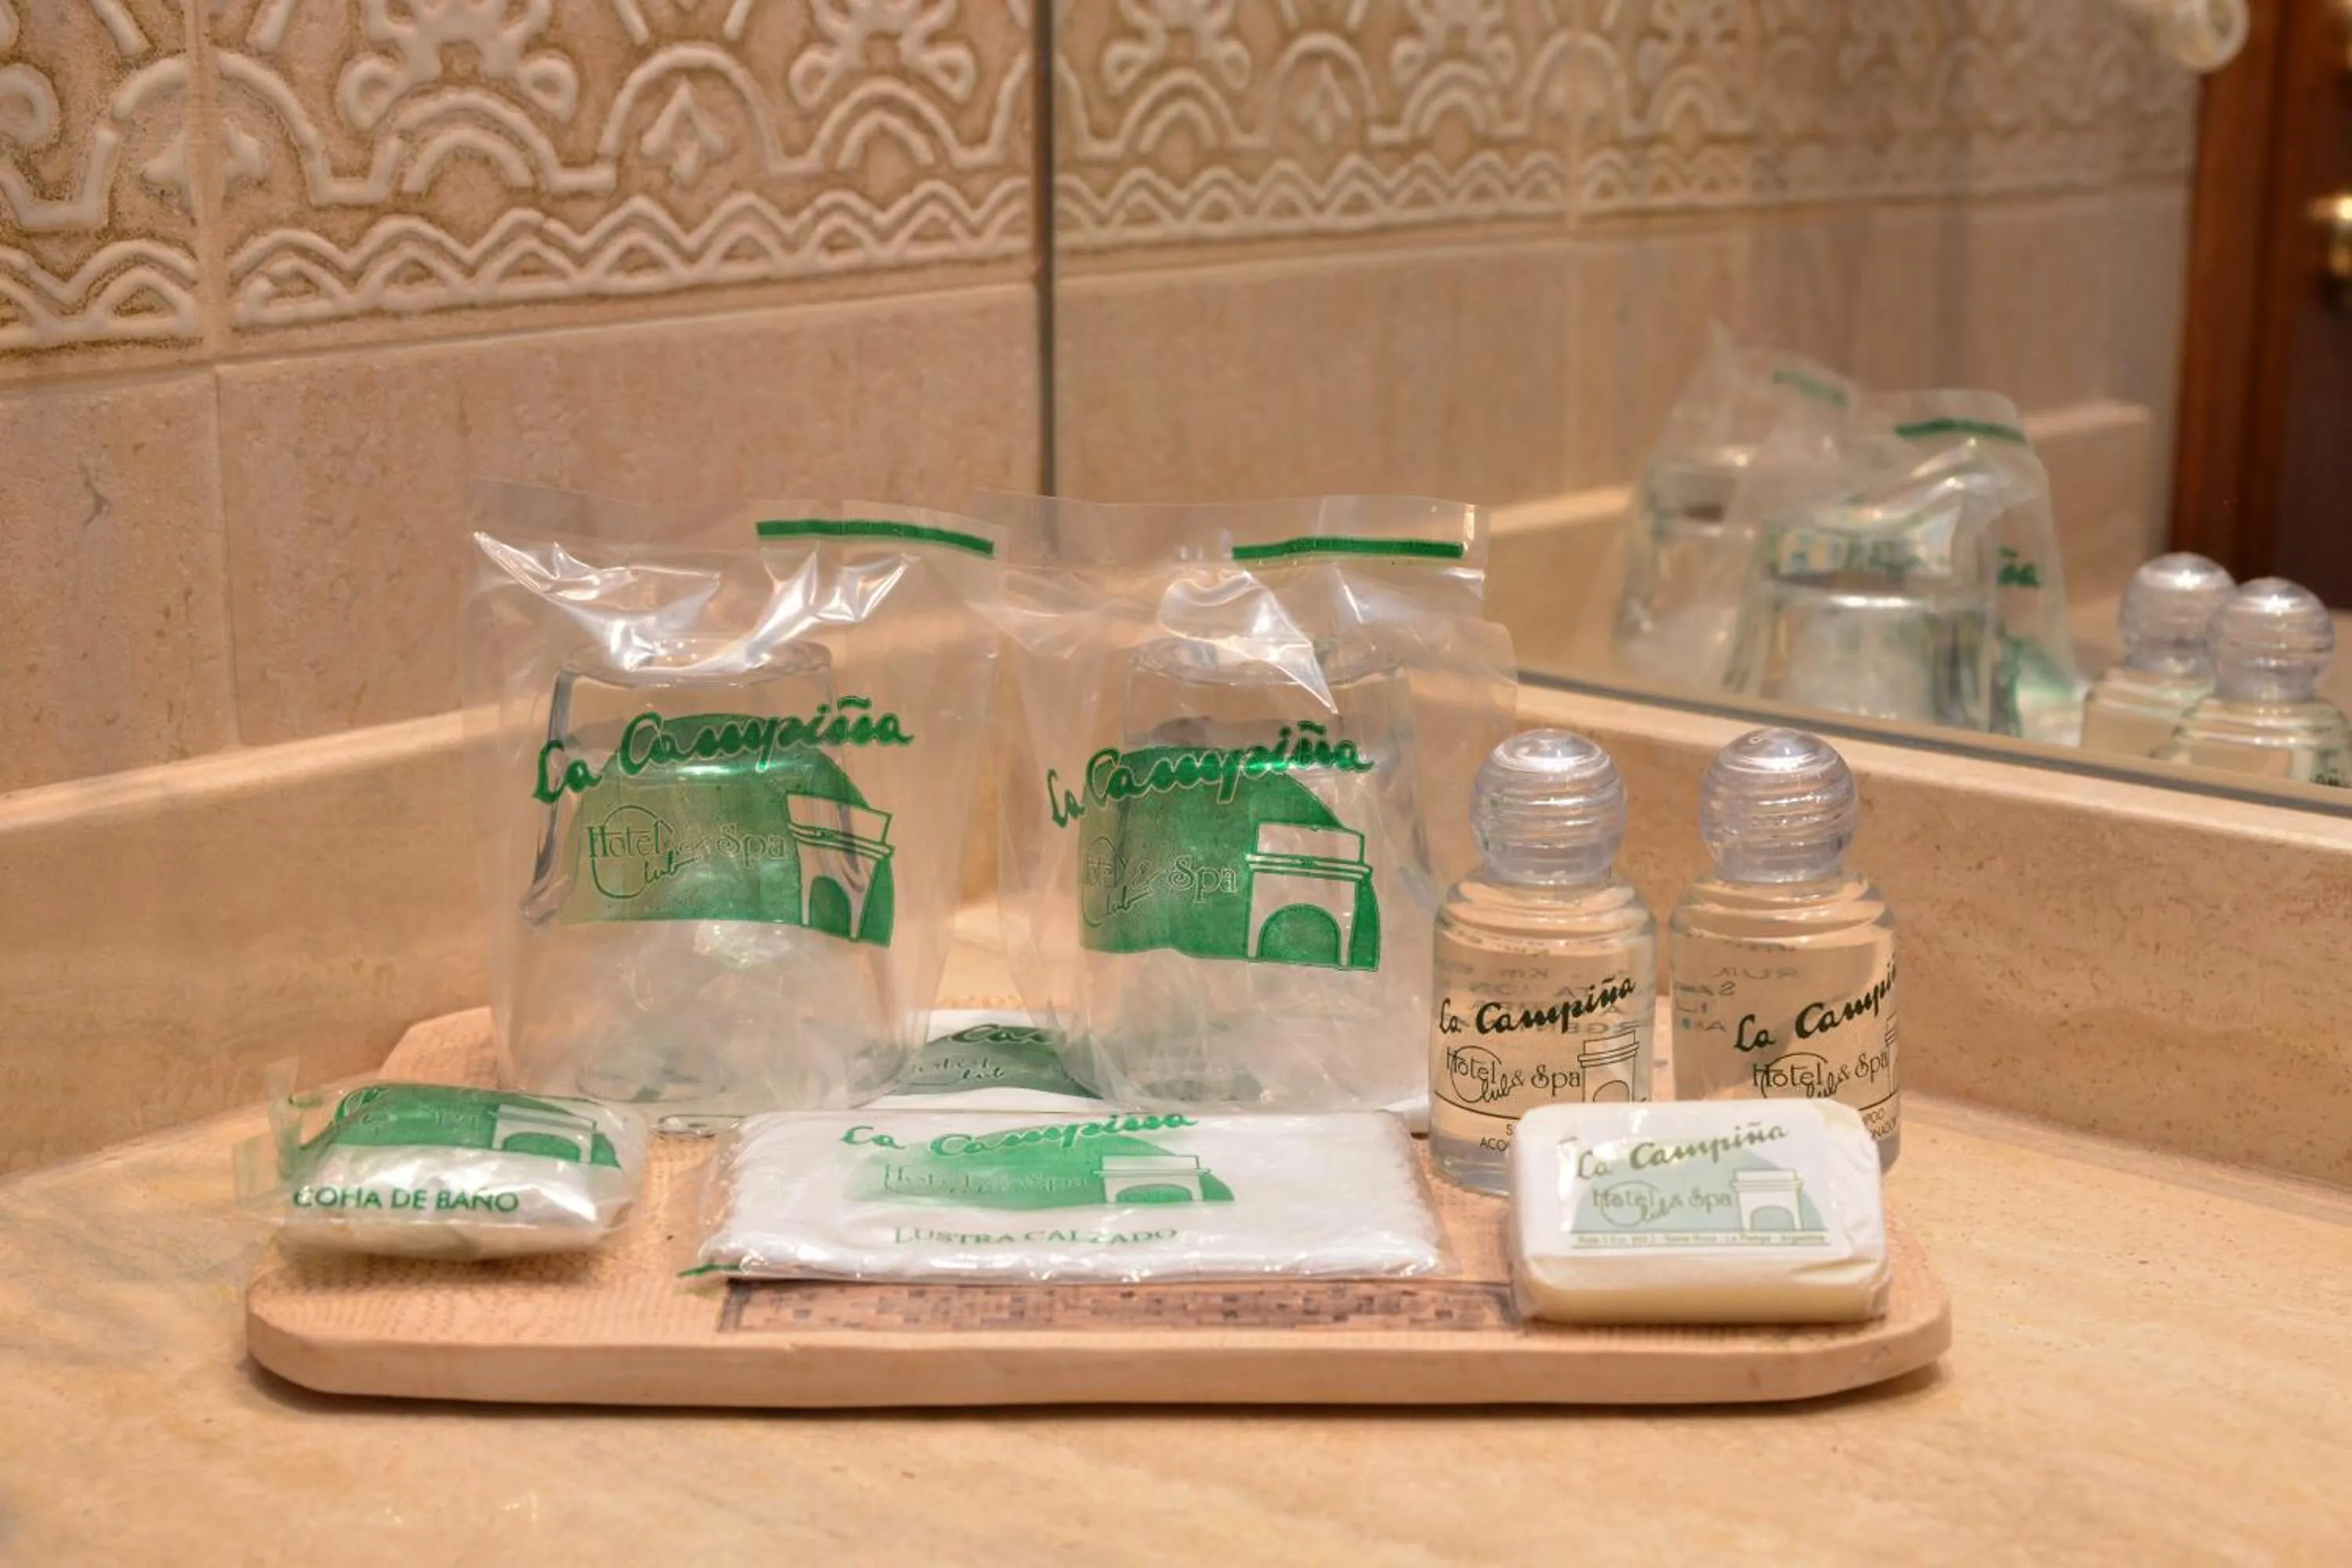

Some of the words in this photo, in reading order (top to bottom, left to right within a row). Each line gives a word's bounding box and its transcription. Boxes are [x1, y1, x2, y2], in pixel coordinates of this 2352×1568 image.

[532, 739, 602, 804] La
[619, 695, 915, 776] Campiña
[1047, 768, 1087, 829] La
[1087, 720, 1375, 808] Campiña
[586, 818, 662, 858] Hotel
[715, 823, 786, 869] Spa
[1167, 854, 1238, 904] Spa
[1439, 997, 1462, 1034] La
[1475, 976, 1637, 1035] Campiña
[1733, 1014, 1776, 1052] La
[1446, 1045, 1497, 1084] Hotel
[1510, 1069, 1526, 1088] &
[1530, 1063, 1581, 1098] Spa
[1752, 1062, 1823, 1088] Hotel
[1837, 1065, 1851, 1084] &
[1854, 1051, 1889, 1083] Spa
[1576, 1149, 1613, 1181] La
[1628, 1121, 1790, 1171] Campiña
[390, 1186, 429, 1210] DE
[1688, 1186, 1733, 1214] Spa
